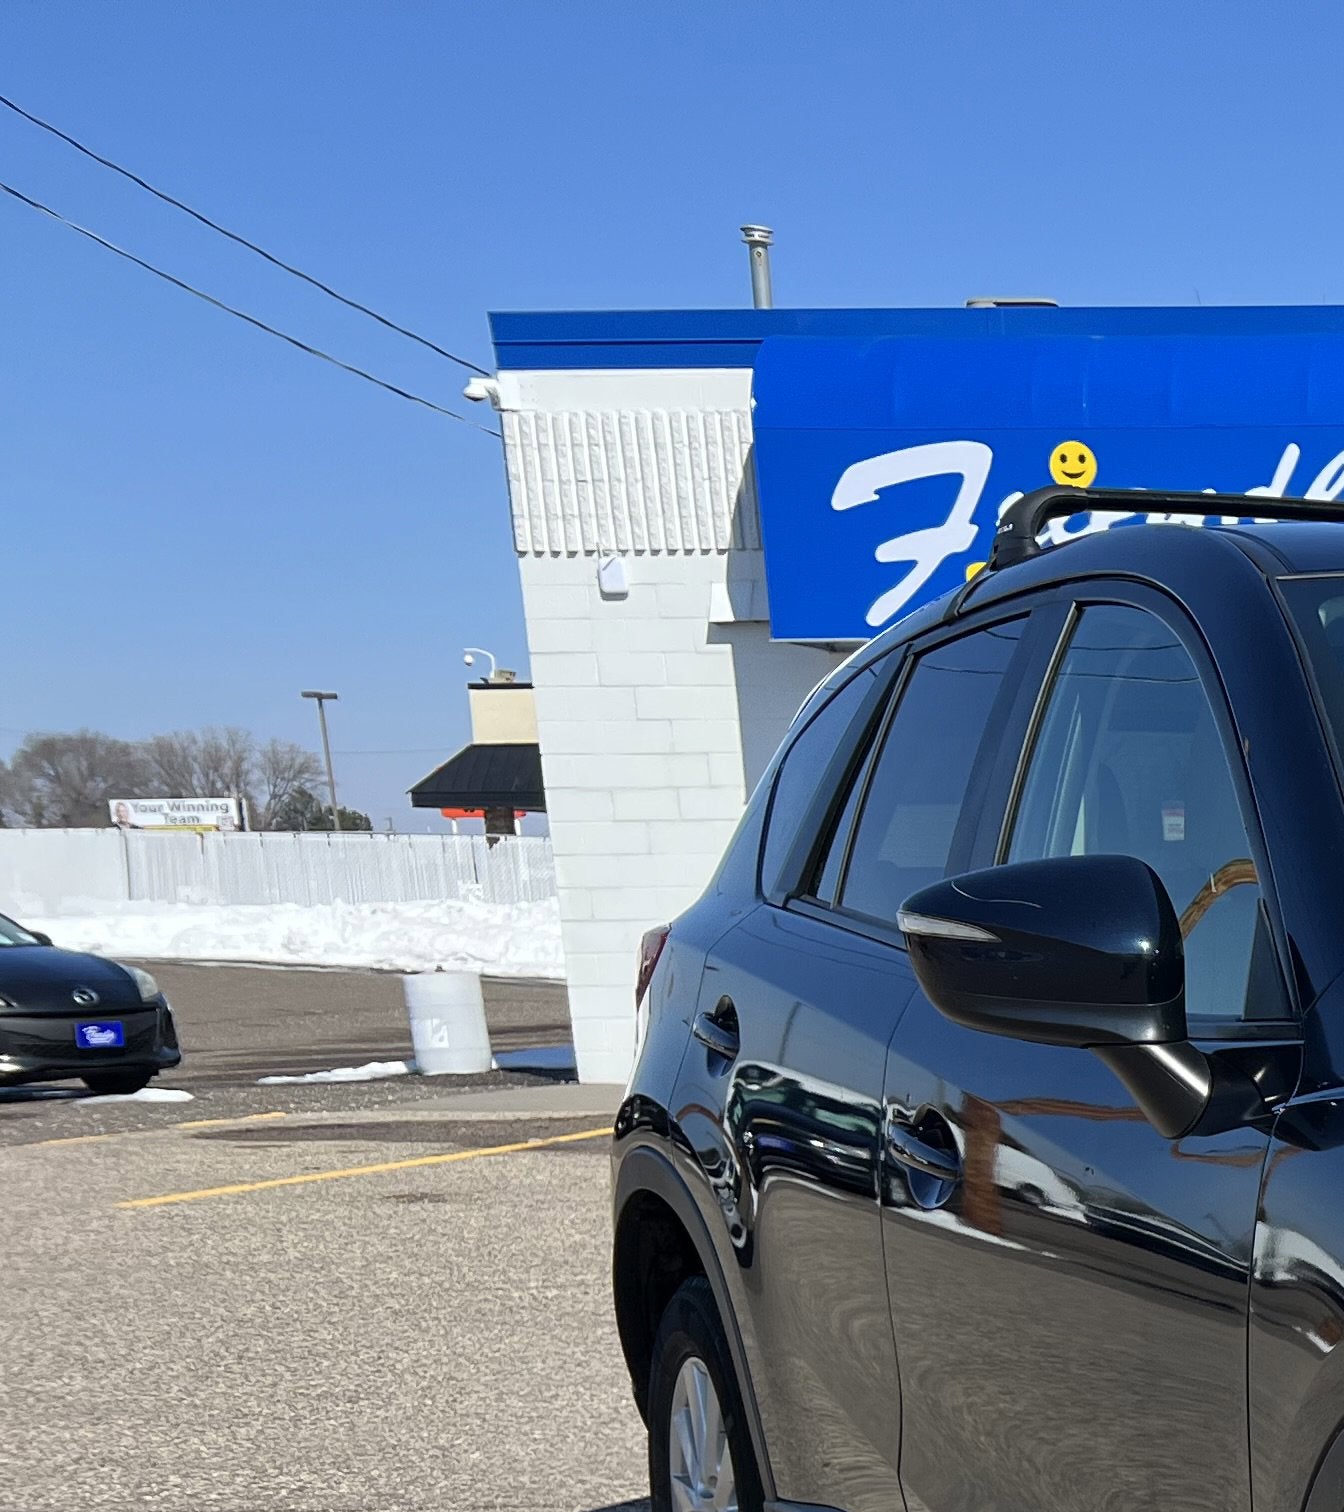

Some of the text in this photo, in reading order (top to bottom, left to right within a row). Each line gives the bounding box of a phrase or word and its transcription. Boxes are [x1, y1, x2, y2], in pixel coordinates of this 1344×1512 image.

[131, 800, 229, 814] Your Winning
[163, 813, 200, 824] Team
